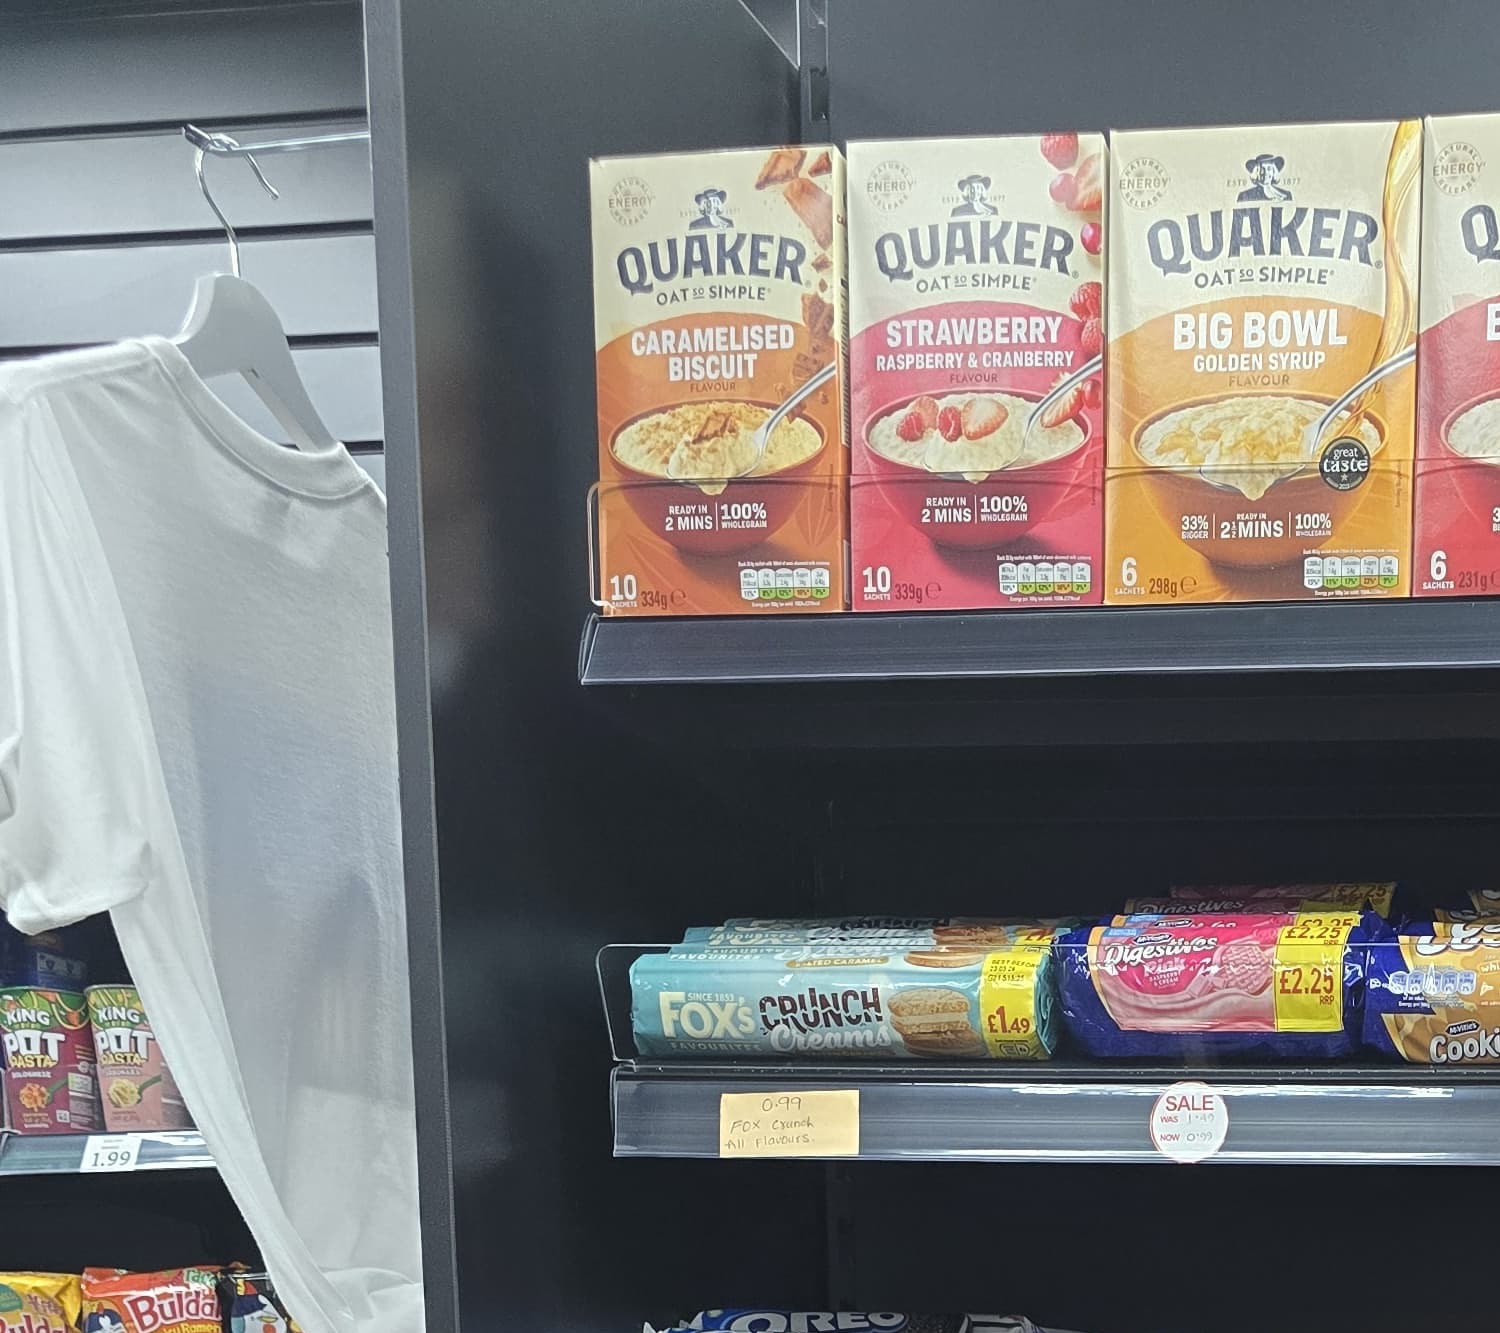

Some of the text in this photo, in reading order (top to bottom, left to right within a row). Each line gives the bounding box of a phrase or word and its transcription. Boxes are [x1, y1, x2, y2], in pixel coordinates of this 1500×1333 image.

[875, 221, 1074, 284] QUAKER
[1147, 208, 1379, 275] QUAKER
[617, 233, 807, 296] QUAKER
[656, 287, 766, 306] OAT SIMPLE
[631, 324, 794, 356] CARAMELISED
[886, 316, 1063, 348] STRAWBERRY
[1173, 307, 1348, 352] BIG BOWL
[668, 354, 758, 382] BISCUIT
[876, 350, 1074, 372] RASPBERRY CRANBERRY
[1193, 351, 1326, 373] GOLDEN SYRUP
[862, 566, 892, 593] 10
[1103, 934, 1218, 966] Digestives
[688, 992, 713, 1002] SINCE
[1279, 967, 1335, 997] £2.25
[6, 1008, 50, 1025] KING
[758, 987, 884, 1032] CRUNCH
[988, 1005, 1030, 1036] £1.49
[4, 1029, 65, 1059] POT
[770, 1022, 892, 1053] Creams
[1166, 1095, 1214, 1111] SALE
[730, 1120, 760, 1134] FOX
[91, 1151, 131, 1167] 1.99
[725, 1139, 744, 1149] All
